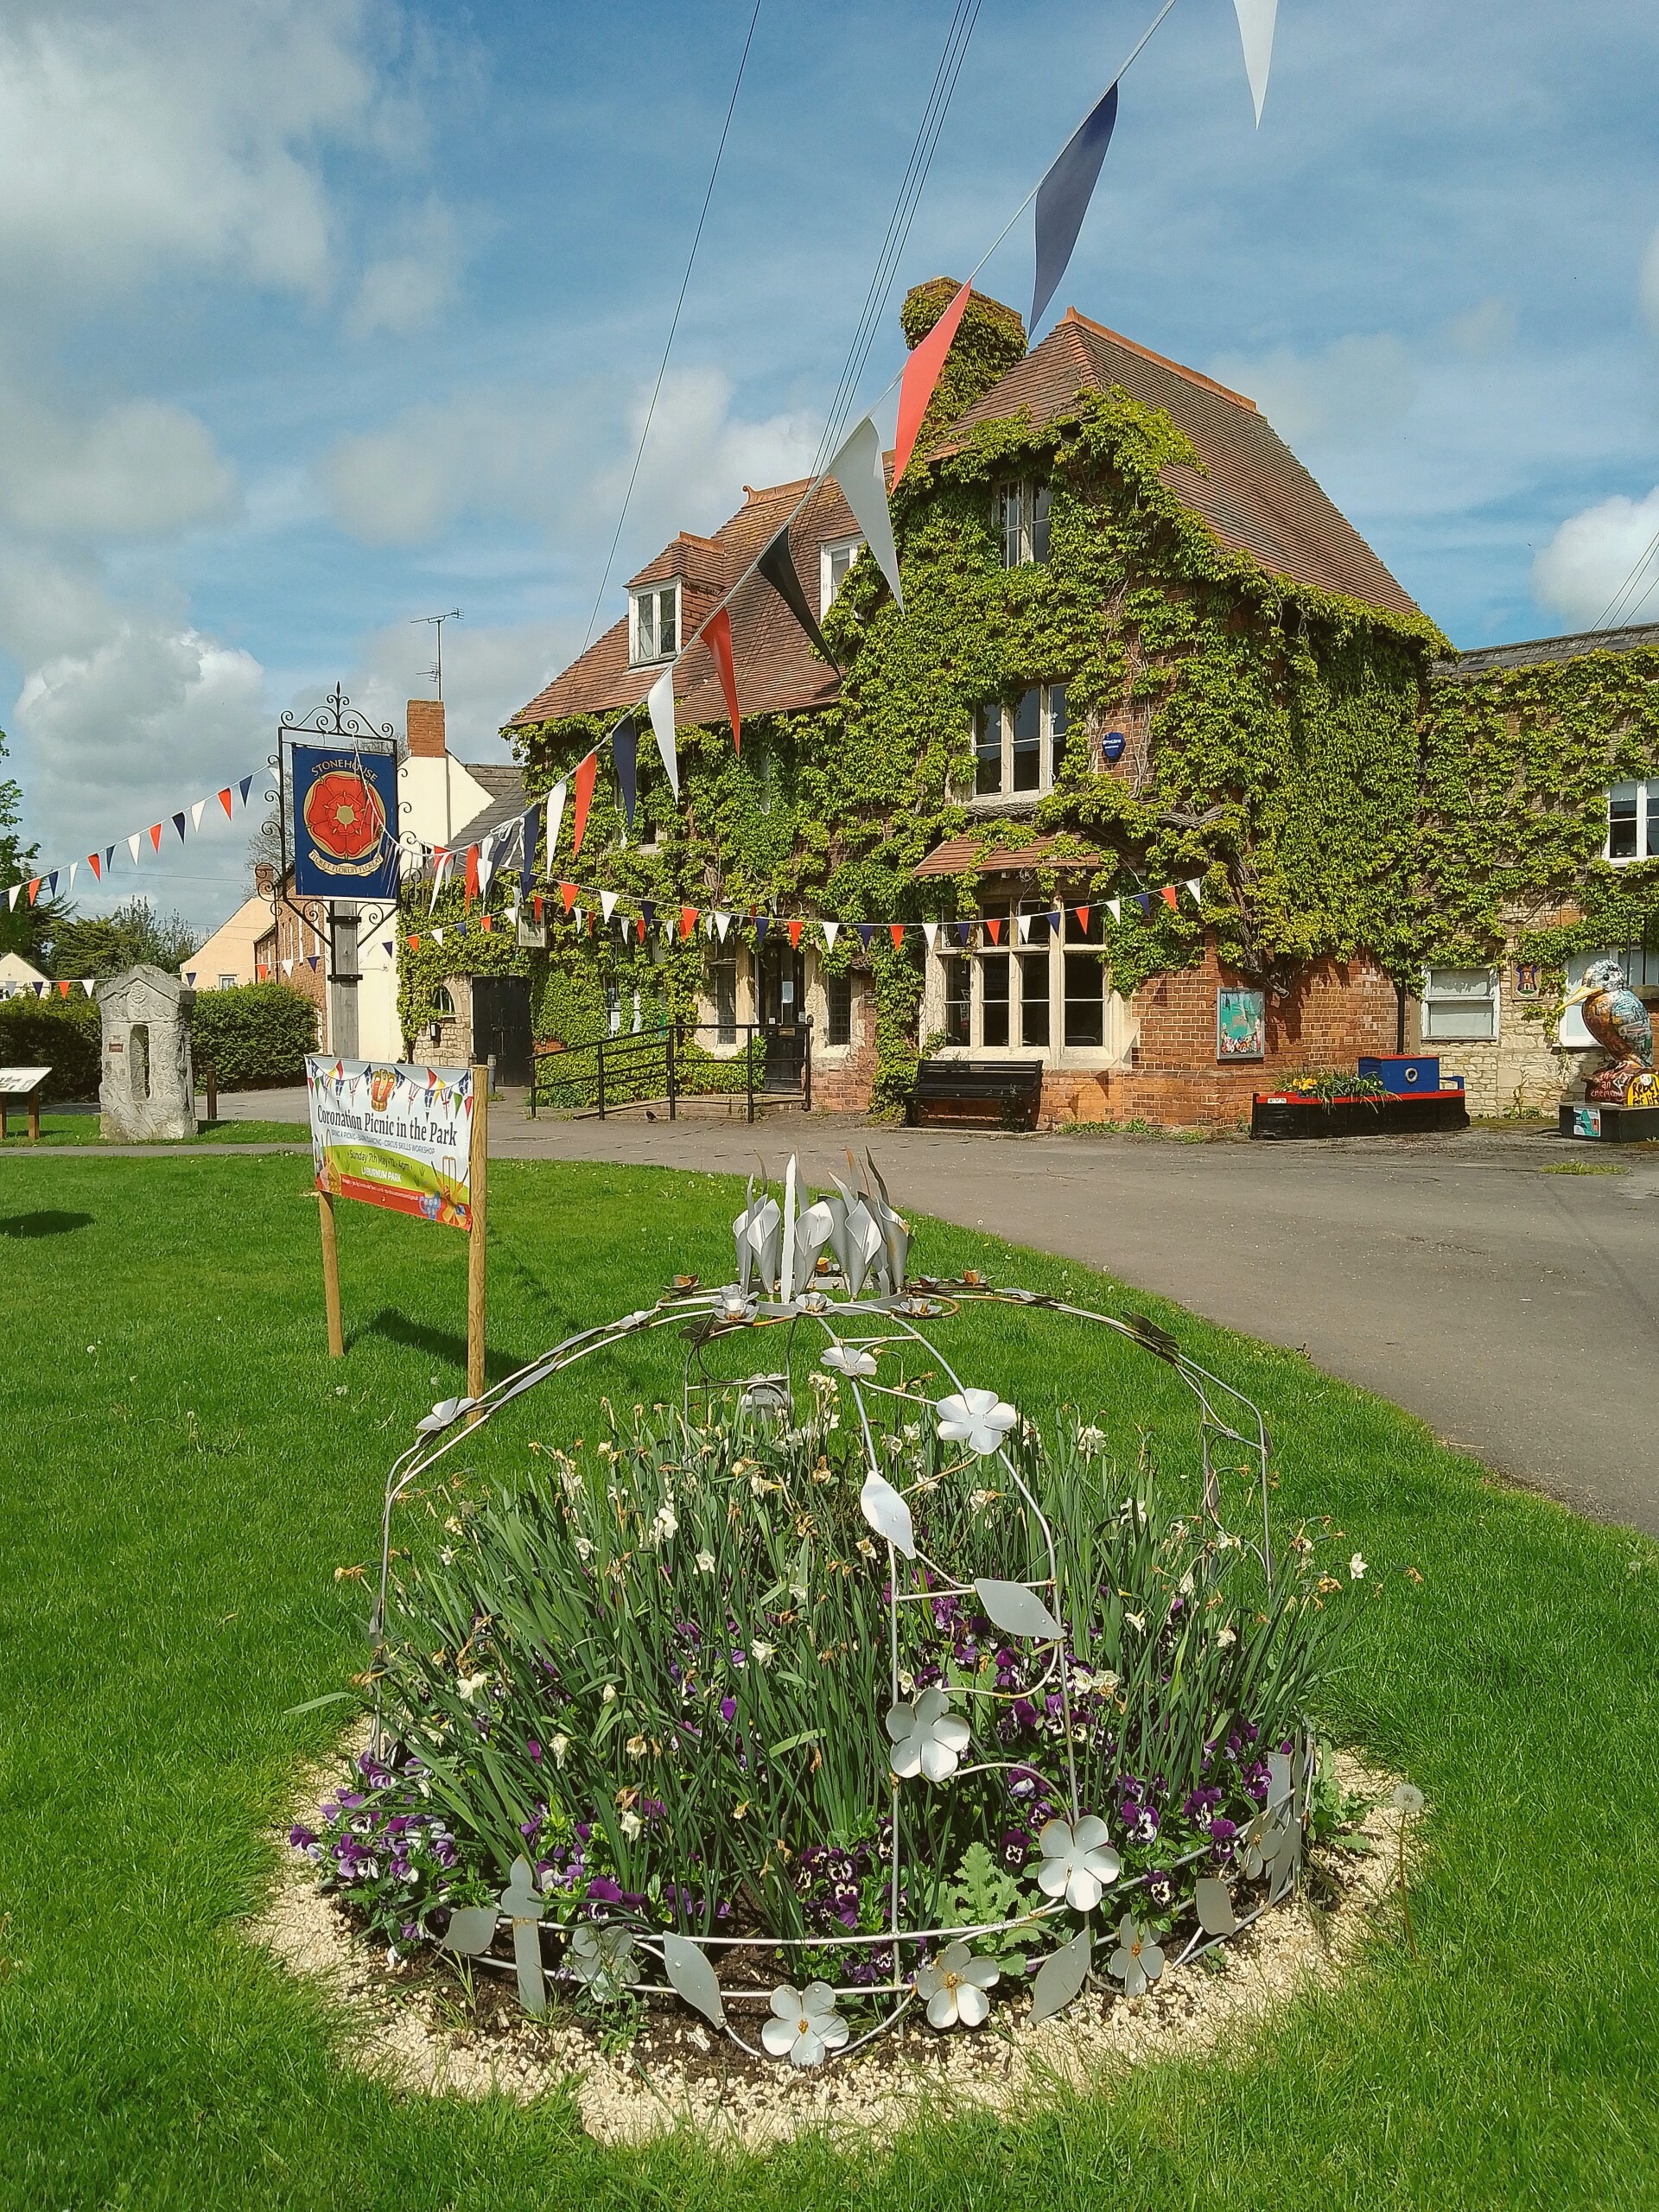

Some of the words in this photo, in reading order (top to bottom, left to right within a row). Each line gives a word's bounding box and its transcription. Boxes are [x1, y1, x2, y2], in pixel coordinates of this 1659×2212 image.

[311, 760, 378, 783] STONEHOUSE
[311, 853, 332, 868] FLORET
[1632, 1082, 1659, 1098] Rebel
[317, 1104, 362, 1131] Coronation
[364, 1112, 394, 1136] Picnic
[397, 1116, 407, 1138] in
[410, 1117, 427, 1141] the
[429, 1122, 457, 1146] Park
[384, 1139, 398, 1149] CIRCUS
[398, 1141, 411, 1151] SKILLS
[412, 1144, 435, 1155] WORKSHOP
[349, 1149, 368, 1164] Sunday
[369, 1152, 378, 1164] 7th
[378, 1154, 388, 1168] May
[388, 1172, 402, 1183] PARK
